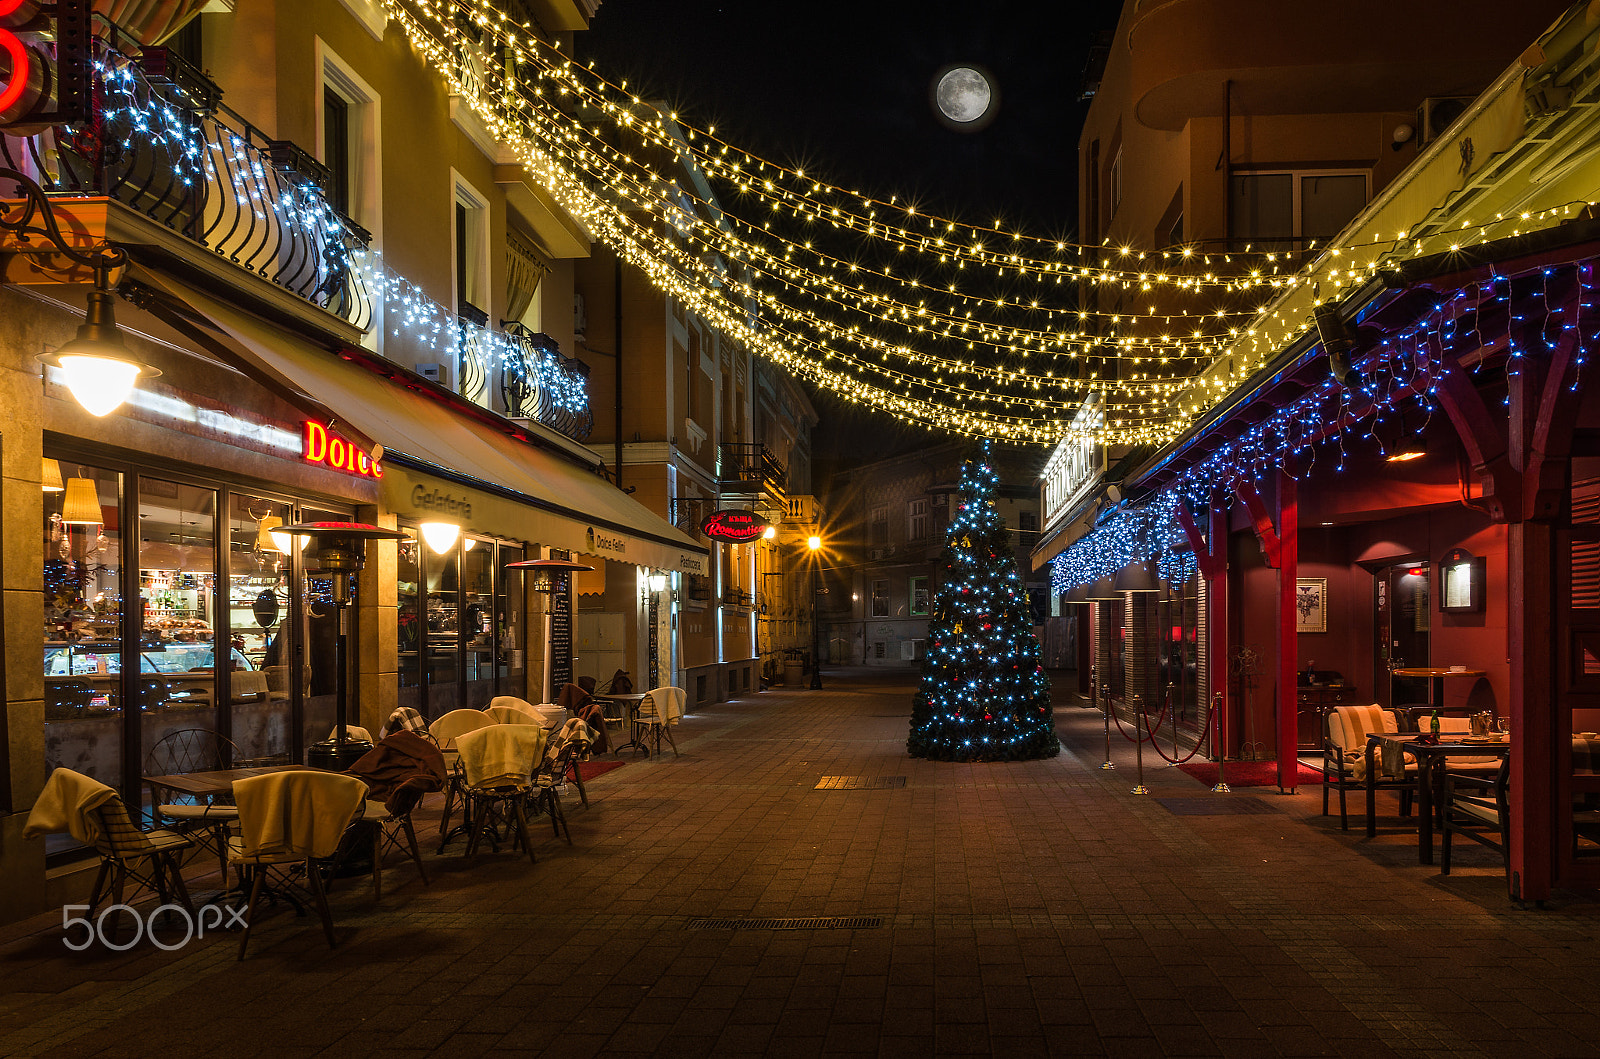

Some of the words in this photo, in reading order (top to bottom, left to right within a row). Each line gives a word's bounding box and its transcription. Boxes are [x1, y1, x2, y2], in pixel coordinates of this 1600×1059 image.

[306, 420, 383, 478] Dolce
[411, 484, 472, 519] Gelateria
[728, 515, 753, 523] КЪЩА
[705, 522, 766, 539] Romantica
[597, 535, 612, 549] Dolce
[612, 536, 626, 553] Fellini
